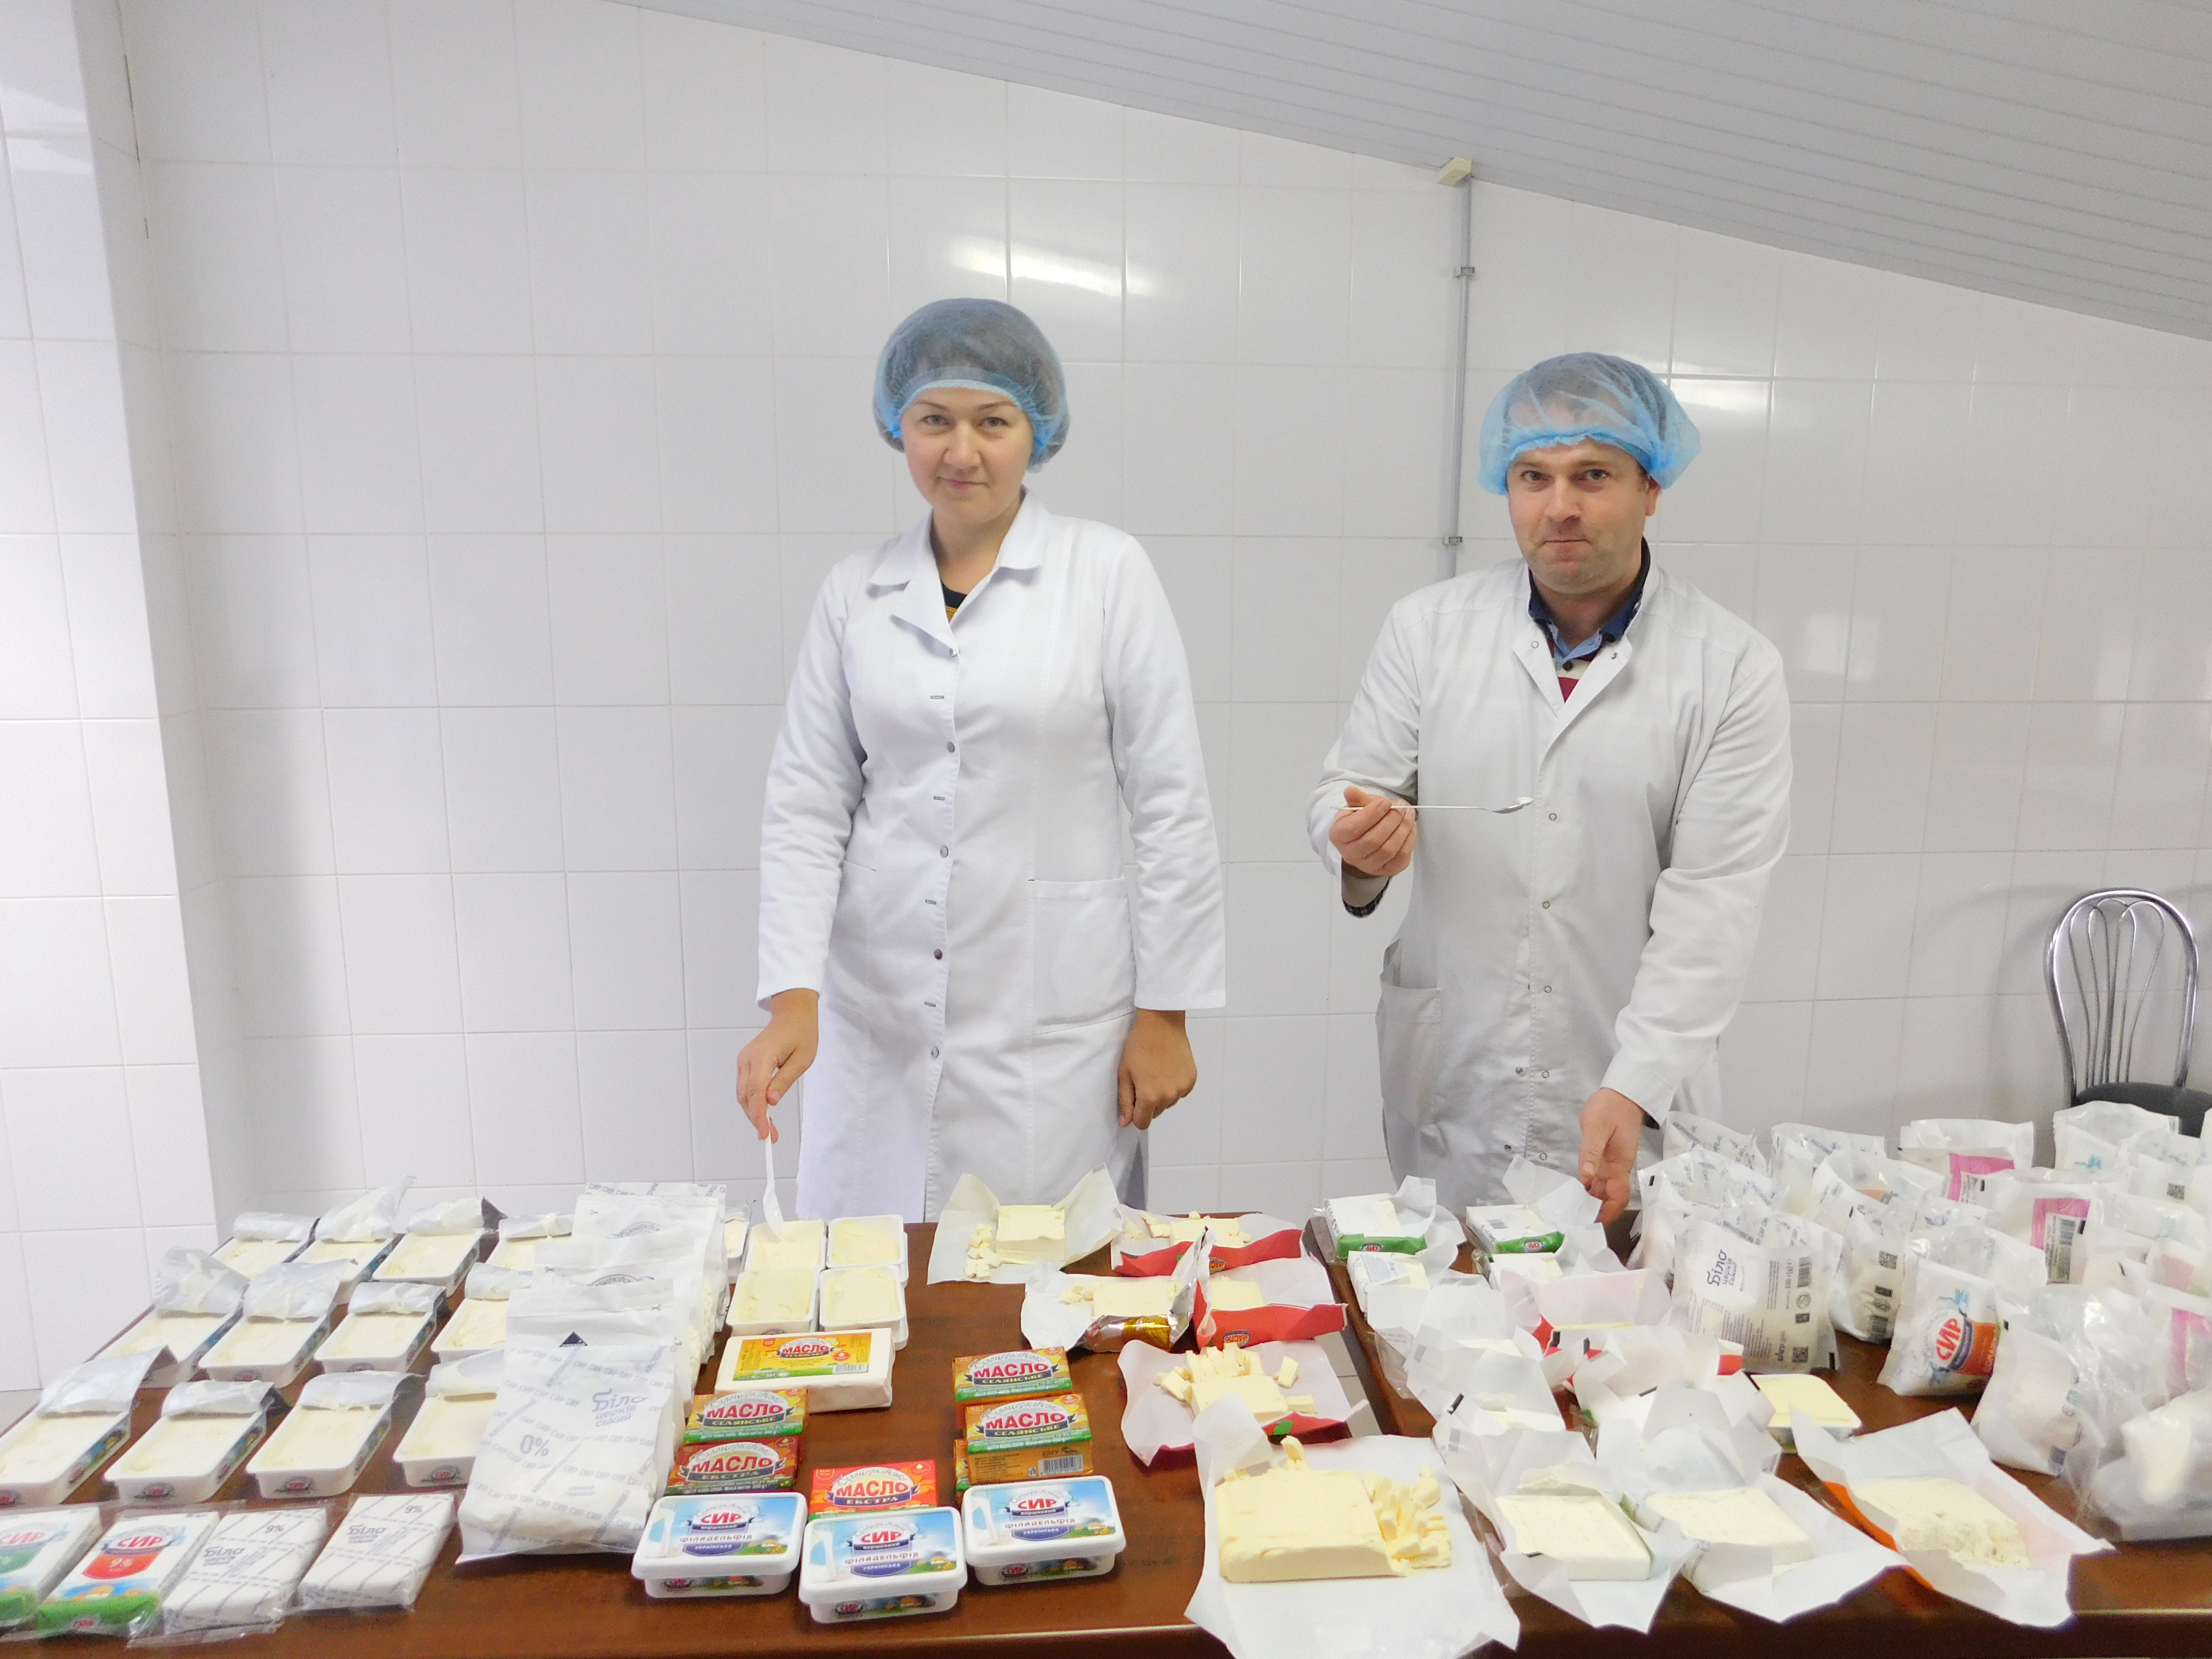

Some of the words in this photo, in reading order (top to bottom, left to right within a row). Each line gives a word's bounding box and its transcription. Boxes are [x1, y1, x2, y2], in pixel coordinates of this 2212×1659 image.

[1707, 1249, 1727, 1286] Біло
[1936, 1318, 1961, 1361] СИР
[781, 1345, 829, 1354] МАСЛО
[974, 1363, 1048, 1378] МАСЛО
[982, 1374, 1044, 1384] СЕЛЯНСЬКЕ
[592, 1388, 649, 1413] Біло
[596, 1405, 637, 1419] церків
[707, 1403, 783, 1419] МАСЛО
[595, 1414, 631, 1427] ський
[712, 1417, 776, 1426] СЕЛЯНСЬКЕ
[986, 1412, 1065, 1430] МАСЛО
[994, 1426, 1060, 1436] СЕЛЯНСЬКЕ
[520, 1434, 550, 1456] 0%
[692, 1456, 773, 1472] МАСЛО
[836, 1480, 909, 1497] МАСЛО
[404, 1505, 423, 1514] 9%
[1017, 1498, 1057, 1509] СИР
[701, 1513, 742, 1524] СИР
[1005, 1518, 1075, 1529] ФІЛАДЕЛЬФІЯ
[265, 1524, 286, 1533] 9%
[347, 1524, 387, 1535] Біло
[118, 1536, 164, 1548] СИР
[861, 1531, 902, 1543] СИР
[203, 1546, 246, 1557] Біло
[845, 1552, 919, 1564] ФІЛАДЕЛЬФІЯ
